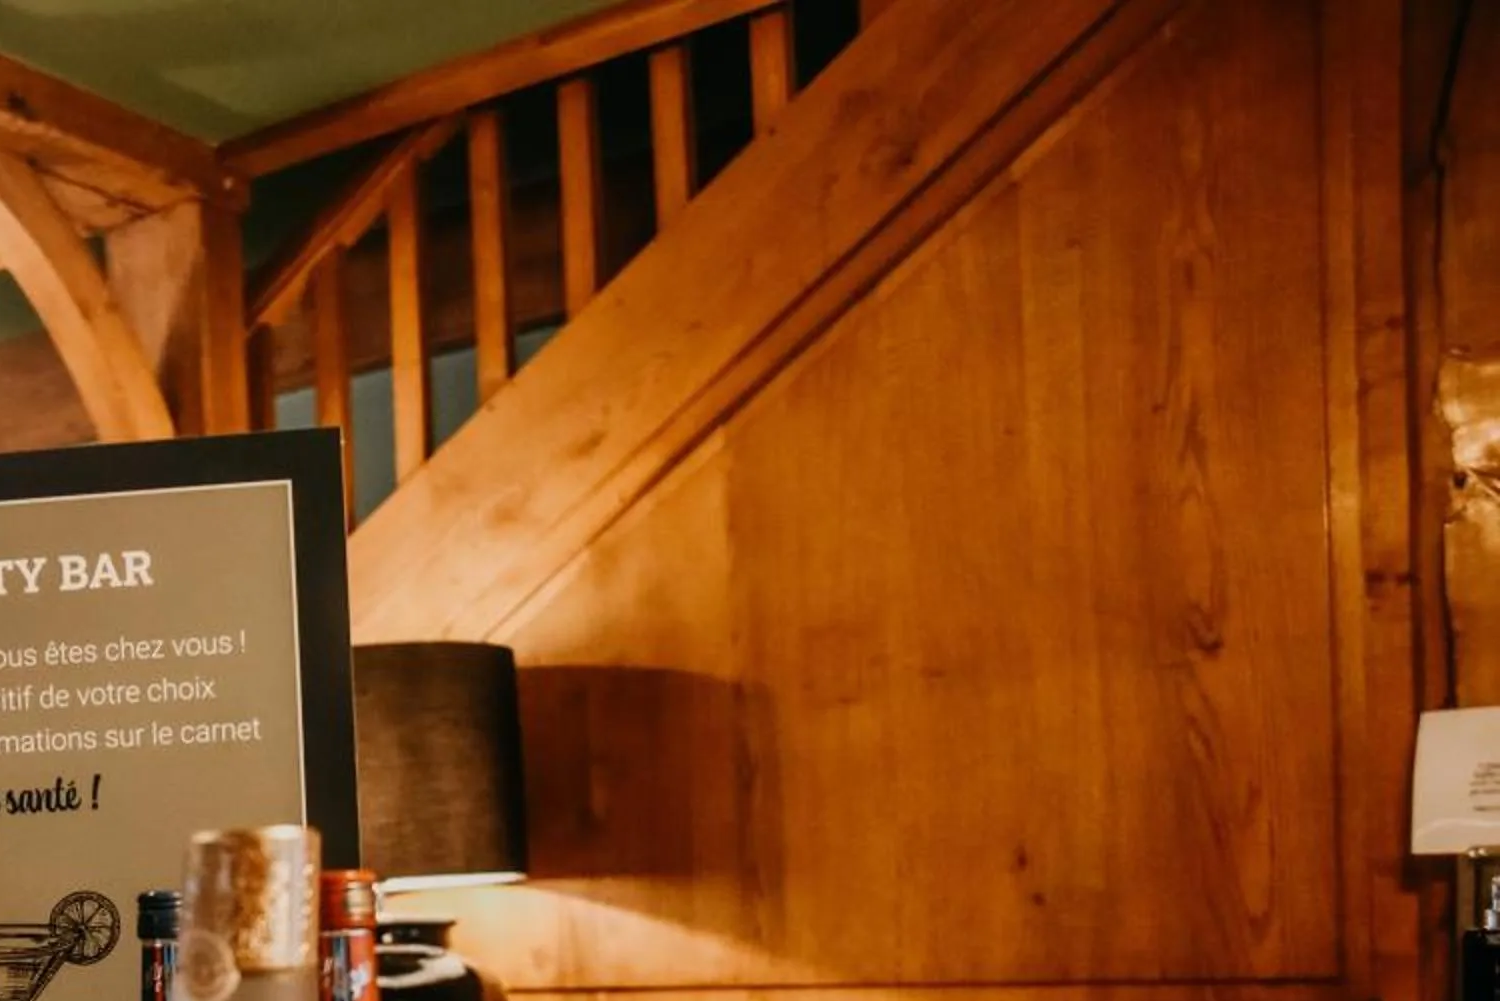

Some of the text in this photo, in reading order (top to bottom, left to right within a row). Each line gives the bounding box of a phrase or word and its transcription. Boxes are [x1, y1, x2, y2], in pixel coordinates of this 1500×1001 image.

[57, 550, 155, 592] BAR
[44, 639, 98, 666] êtes
[104, 635, 165, 662] chez
[171, 633, 234, 658] vous
[239, 628, 247, 655] !
[38, 685, 71, 710] de
[76, 678, 142, 706] votre
[146, 675, 217, 702] choix
[104, 726, 146, 749] sur
[150, 719, 174, 746] le
[180, 716, 262, 744] carnet
[5, 775, 83, 815] santé
[90, 772, 103, 811] !
